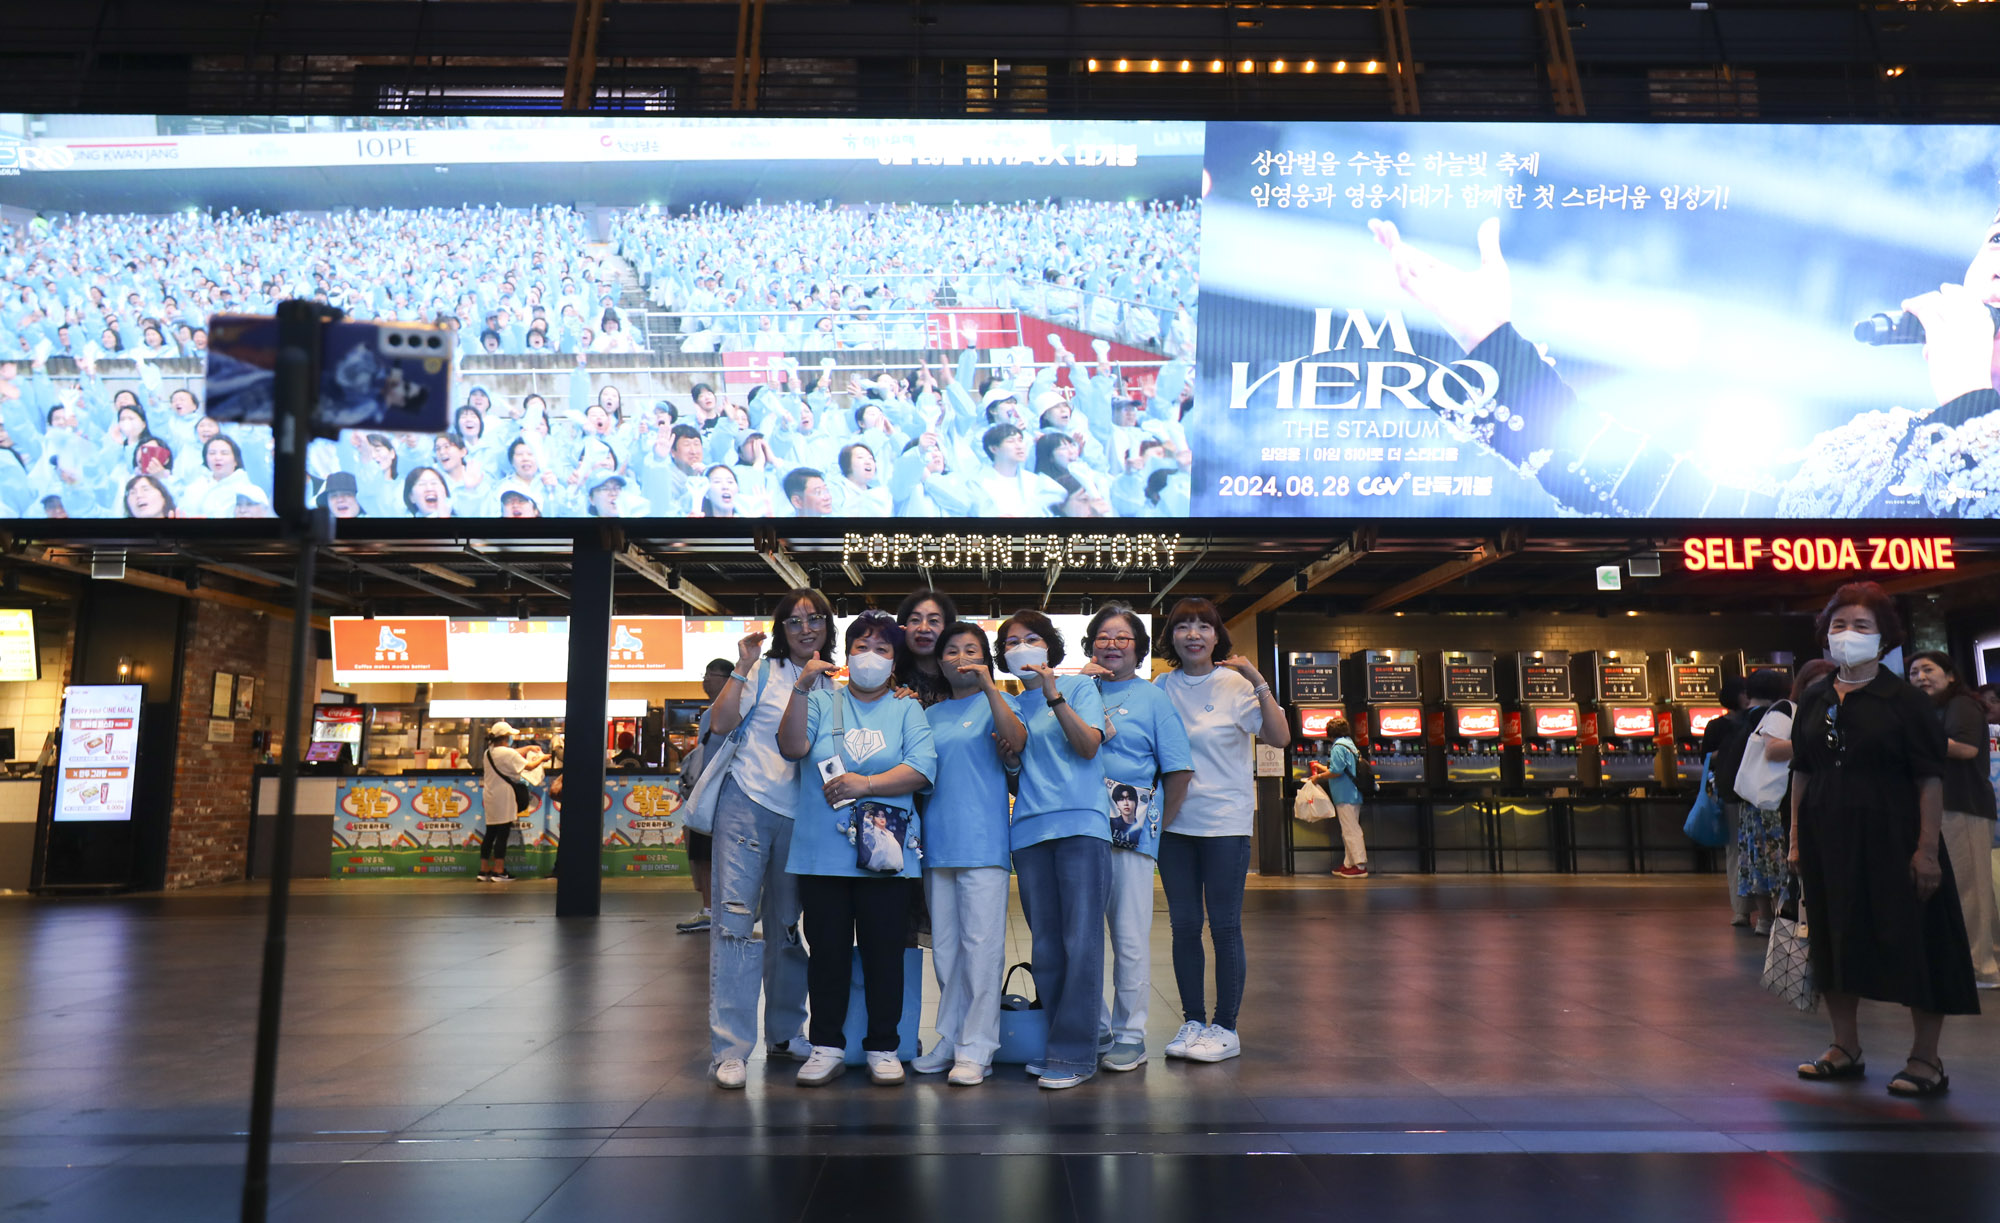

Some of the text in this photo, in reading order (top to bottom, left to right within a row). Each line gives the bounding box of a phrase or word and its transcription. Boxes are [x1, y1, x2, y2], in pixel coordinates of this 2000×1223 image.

[104, 149, 143, 162] KWAN
[145, 147, 178, 162] JANG
[357, 137, 419, 158] IOPE
[1250, 150, 1541, 177] 상암벌을 수놓은 하늘빛 축제
[1250, 183, 1730, 211] 임영웅과 영웅시대가 함께한 첫 스타디움 입성기!
[1311, 307, 1417, 356] IM
[1229, 355, 1500, 413] HERO
[1283, 420, 1441, 439] THE STADIUM
[1261, 447, 1459, 462] 임영웅 아임 히어로 더 스타디움
[1357, 474, 1405, 496] CGV
[1412, 476, 1493, 496] 단독개봉
[843, 533, 1181, 568] POPCORN FACTORY
[1684, 537, 1955, 571] SELF SODA ZONE
[71, 707, 88, 715] Enjoy
[102, 706, 116, 714] CINE
[117, 706, 134, 714] MEAL
